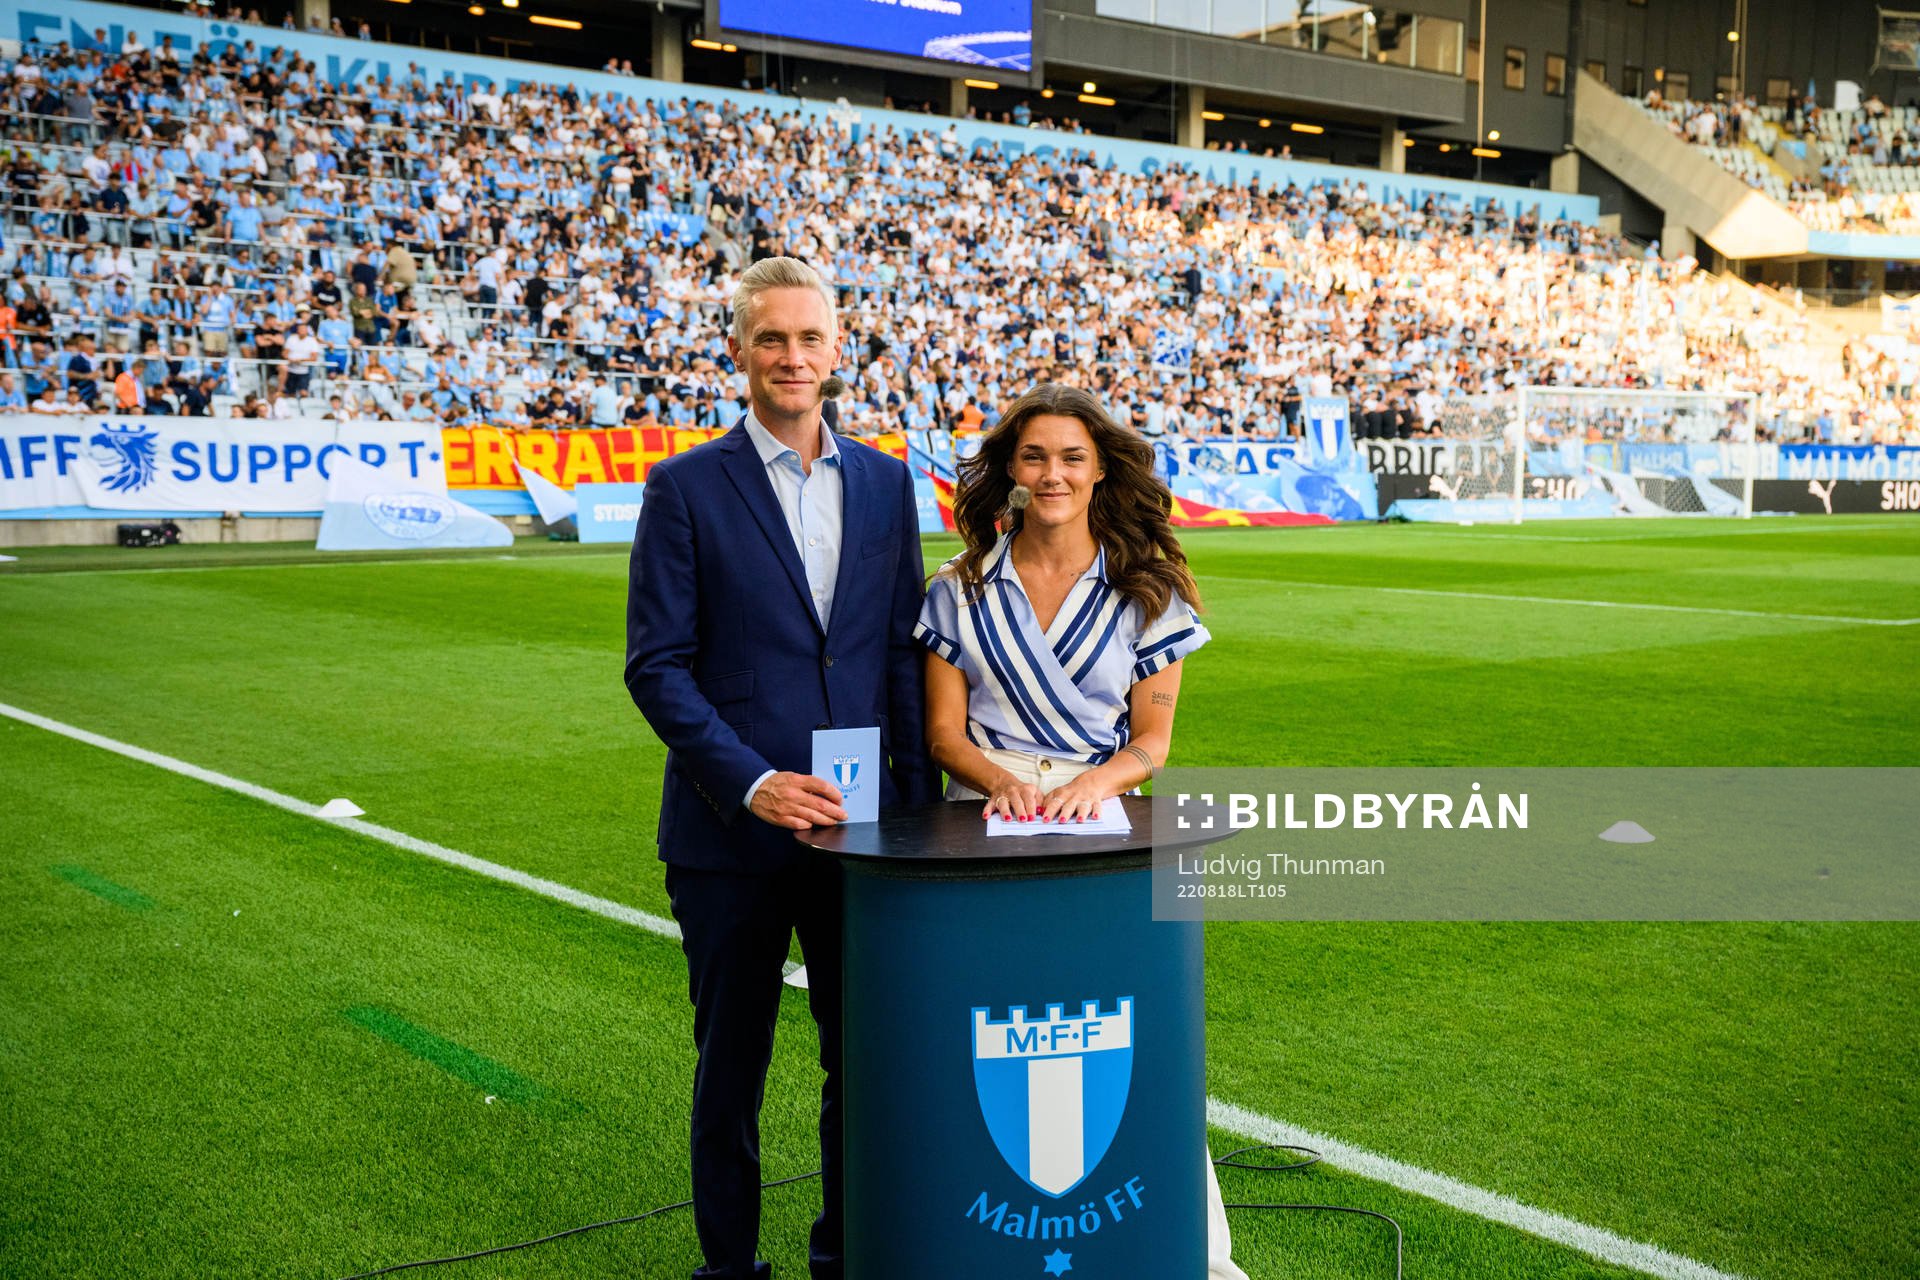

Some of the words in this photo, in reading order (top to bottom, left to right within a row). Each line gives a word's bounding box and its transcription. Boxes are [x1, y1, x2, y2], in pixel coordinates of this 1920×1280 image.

[0, 435, 80, 479] FF
[965, 1191, 1102, 1240] Malmö
[1104, 1175, 1145, 1223] FF
